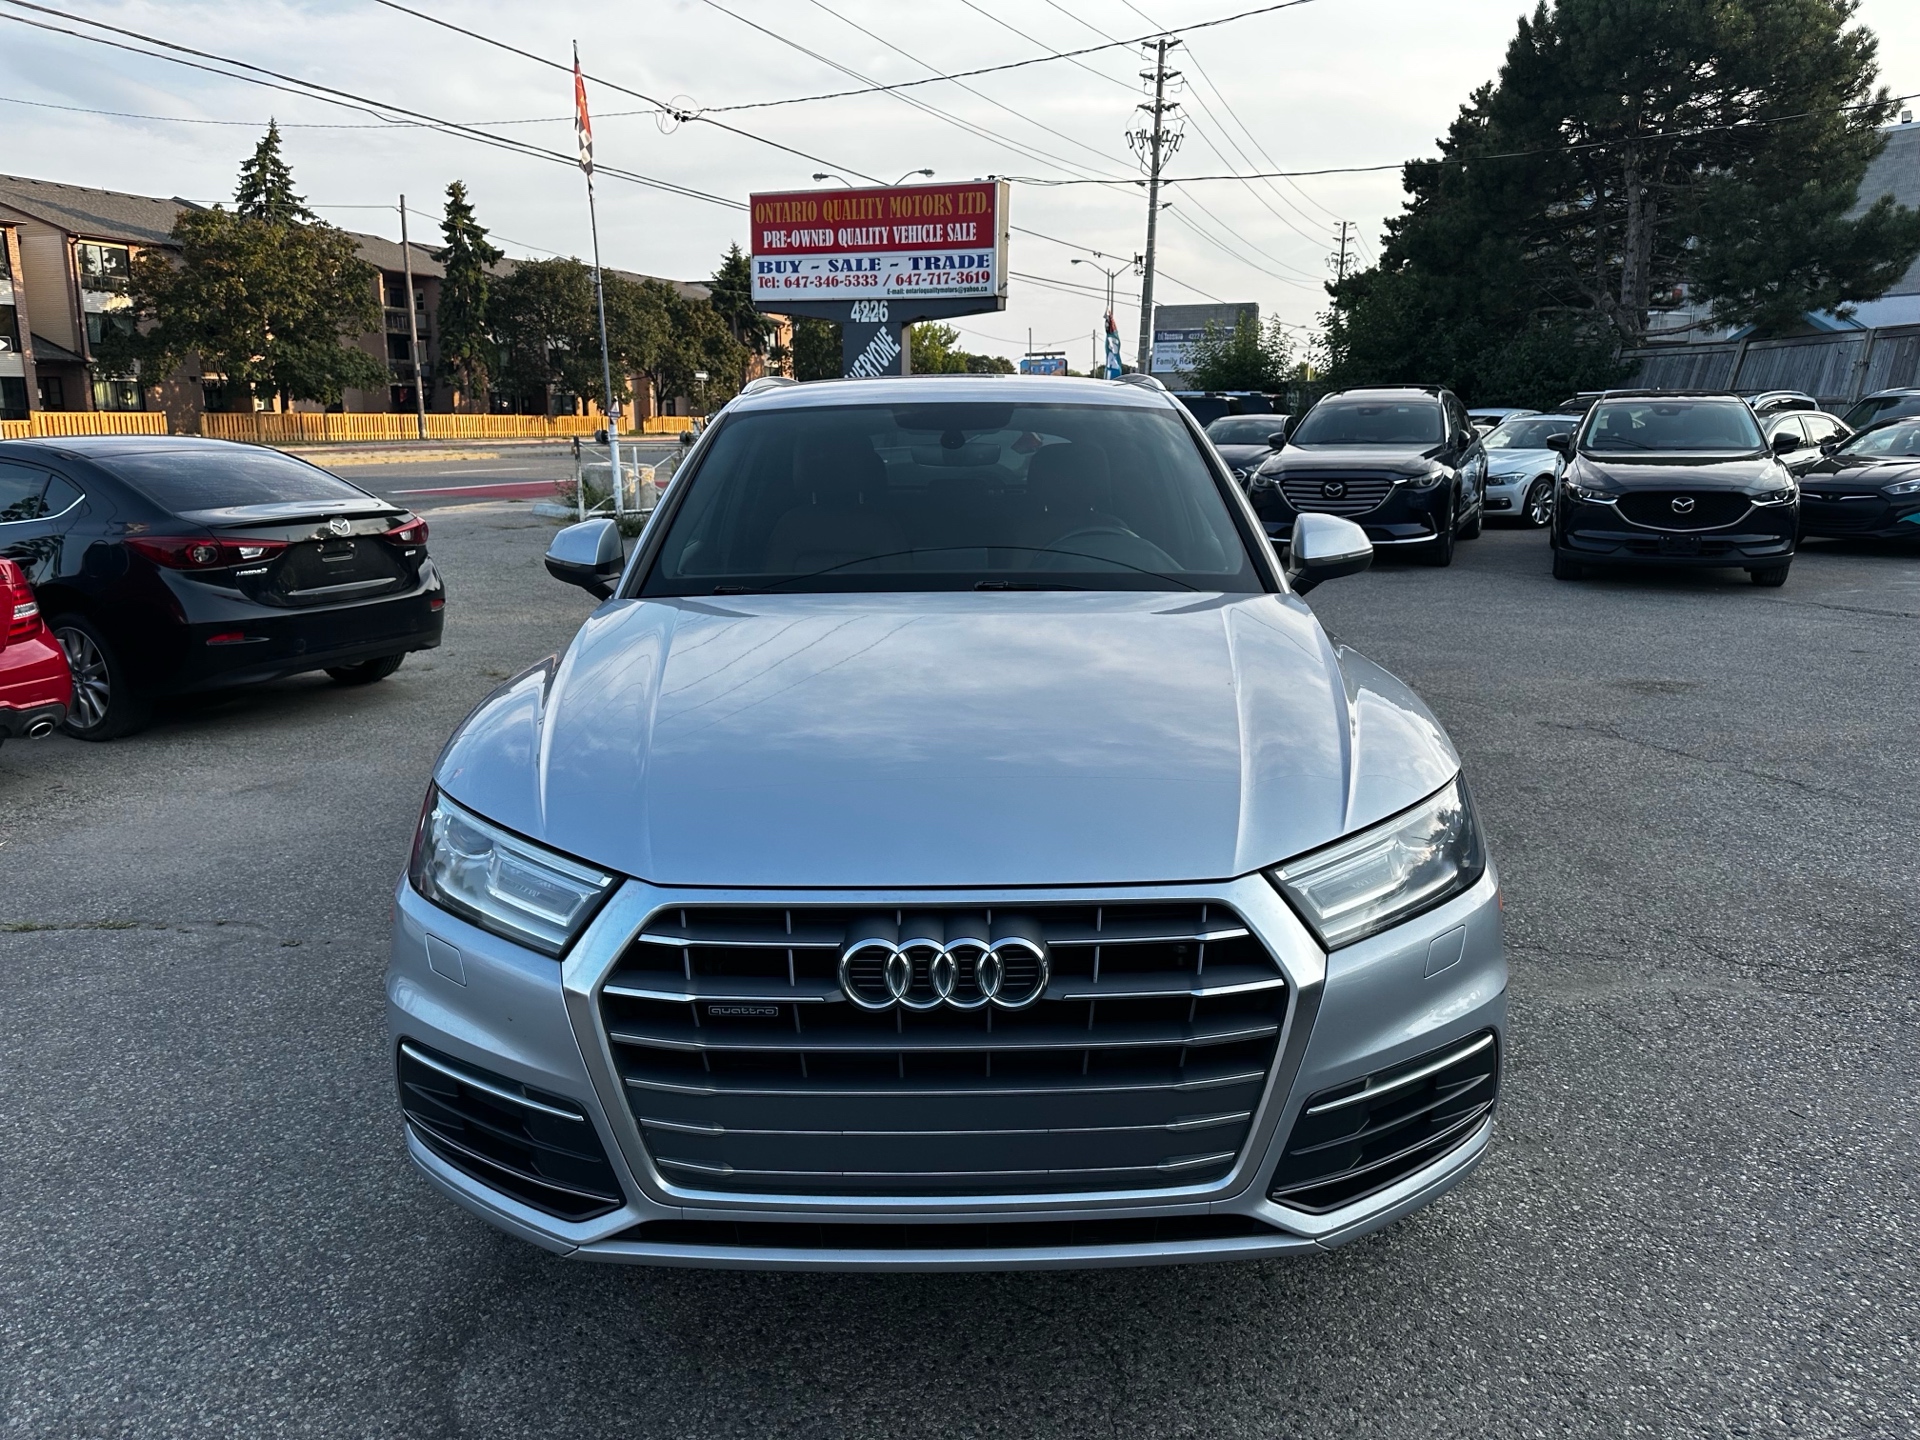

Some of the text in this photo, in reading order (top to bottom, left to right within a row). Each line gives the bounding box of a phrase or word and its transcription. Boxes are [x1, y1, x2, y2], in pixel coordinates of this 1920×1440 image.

[755, 191, 991, 224] ONTARIO QUALITY MOTORS LTD.
[763, 222, 977, 248] PRE-OWNED QUALITY VEHICLE SALE
[757, 260, 802, 274] BUY
[828, 257, 881, 273] SALE
[908, 254, 990, 271] TRADE
[757, 270, 990, 289] Tel: 647-346-5333 / 647-717-3619
[887, 285, 988, 295] E-mail: ontarioqualitymotors@yahoo.ca
[850, 300, 889, 323] 4226
[1156, 357, 1177, 366] Family
[711, 1007, 775, 1015] quattro
